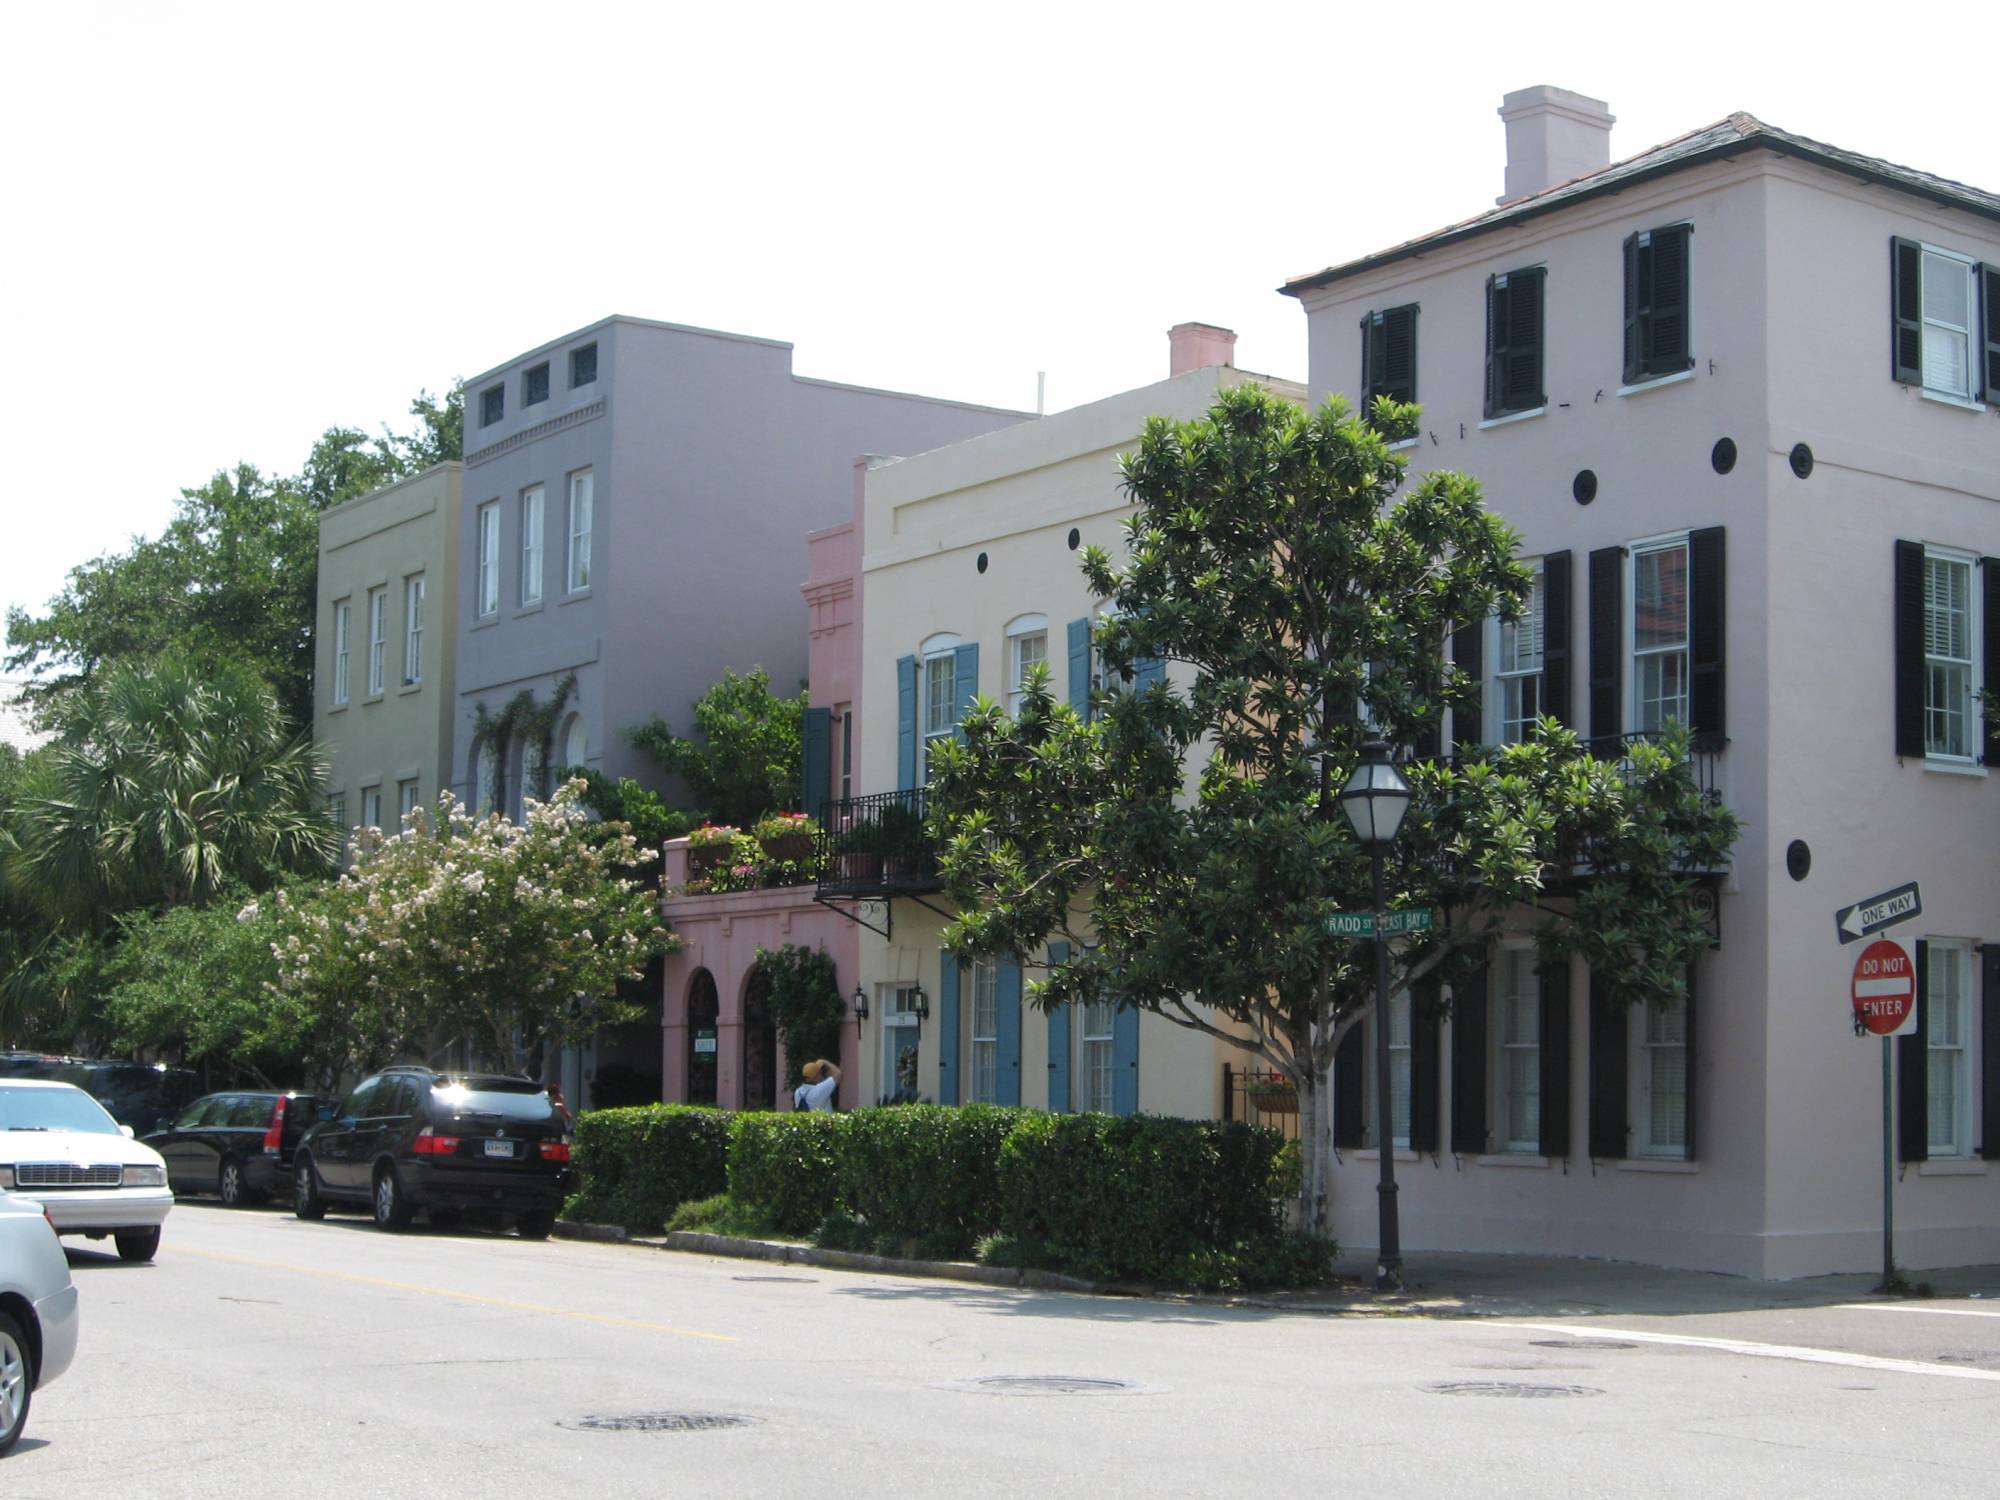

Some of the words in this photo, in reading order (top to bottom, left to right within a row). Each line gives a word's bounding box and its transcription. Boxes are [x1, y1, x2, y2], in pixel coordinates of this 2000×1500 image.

[1862, 906, 1885, 925] ONE
[1888, 894, 1912, 914] WAY
[1328, 916, 1361, 932] RADD
[1406, 911, 1421, 930] BAY
[1863, 959, 1878, 975] DO
[1882, 957, 1905, 974] NOT
[1863, 1000, 1903, 1017] ENTER
